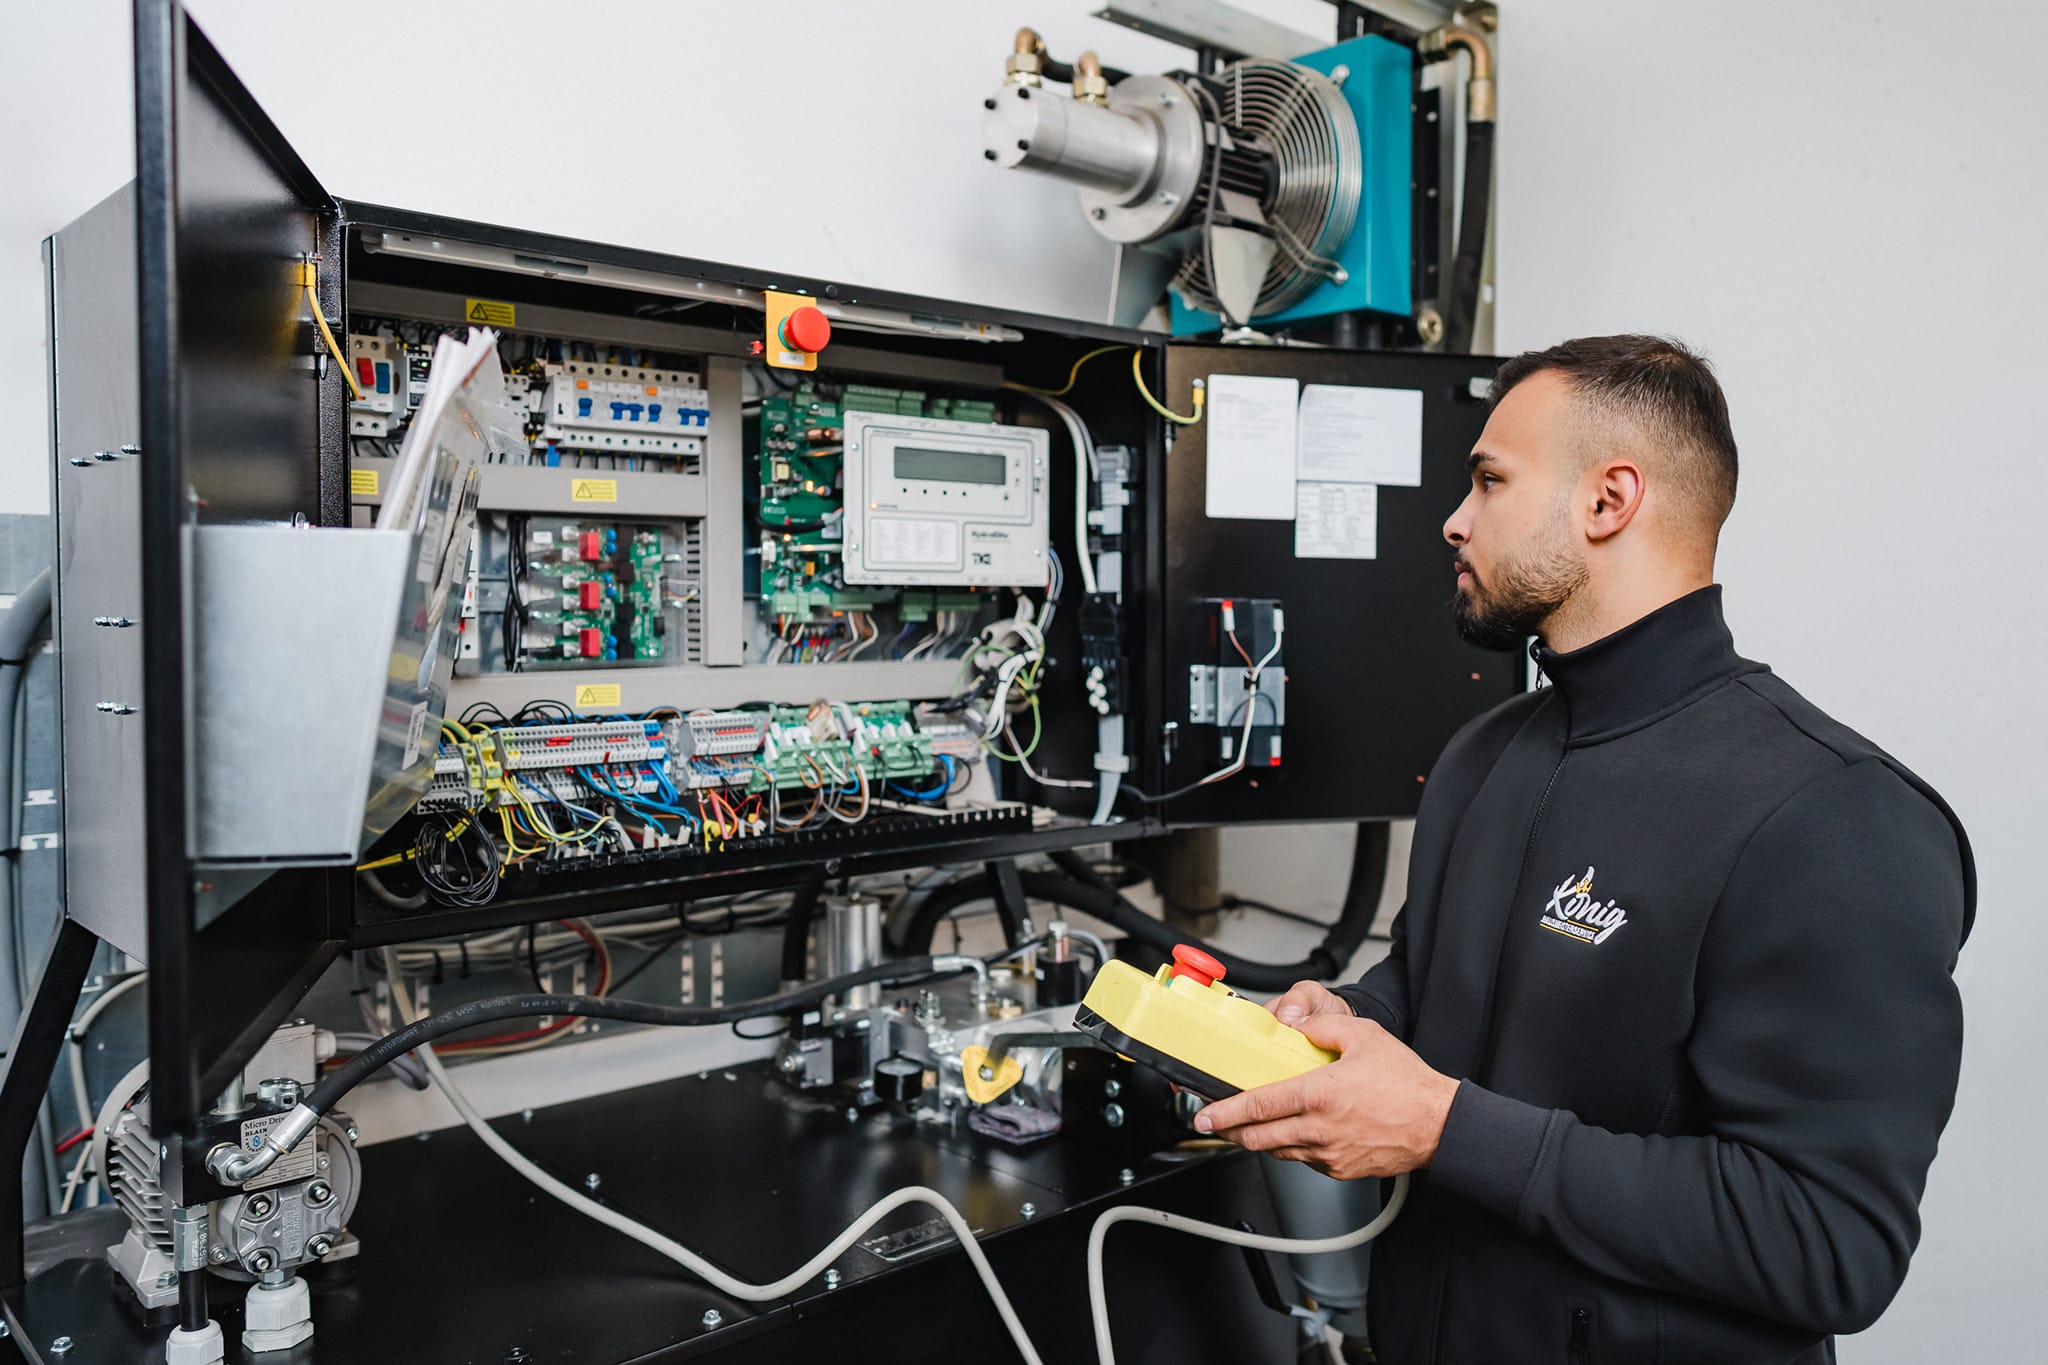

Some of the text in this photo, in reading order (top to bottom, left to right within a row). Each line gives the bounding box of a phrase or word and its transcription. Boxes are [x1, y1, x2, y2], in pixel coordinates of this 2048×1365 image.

[244, 1115, 287, 1130] Micro Driv
[245, 1127, 268, 1137] BLAIN
